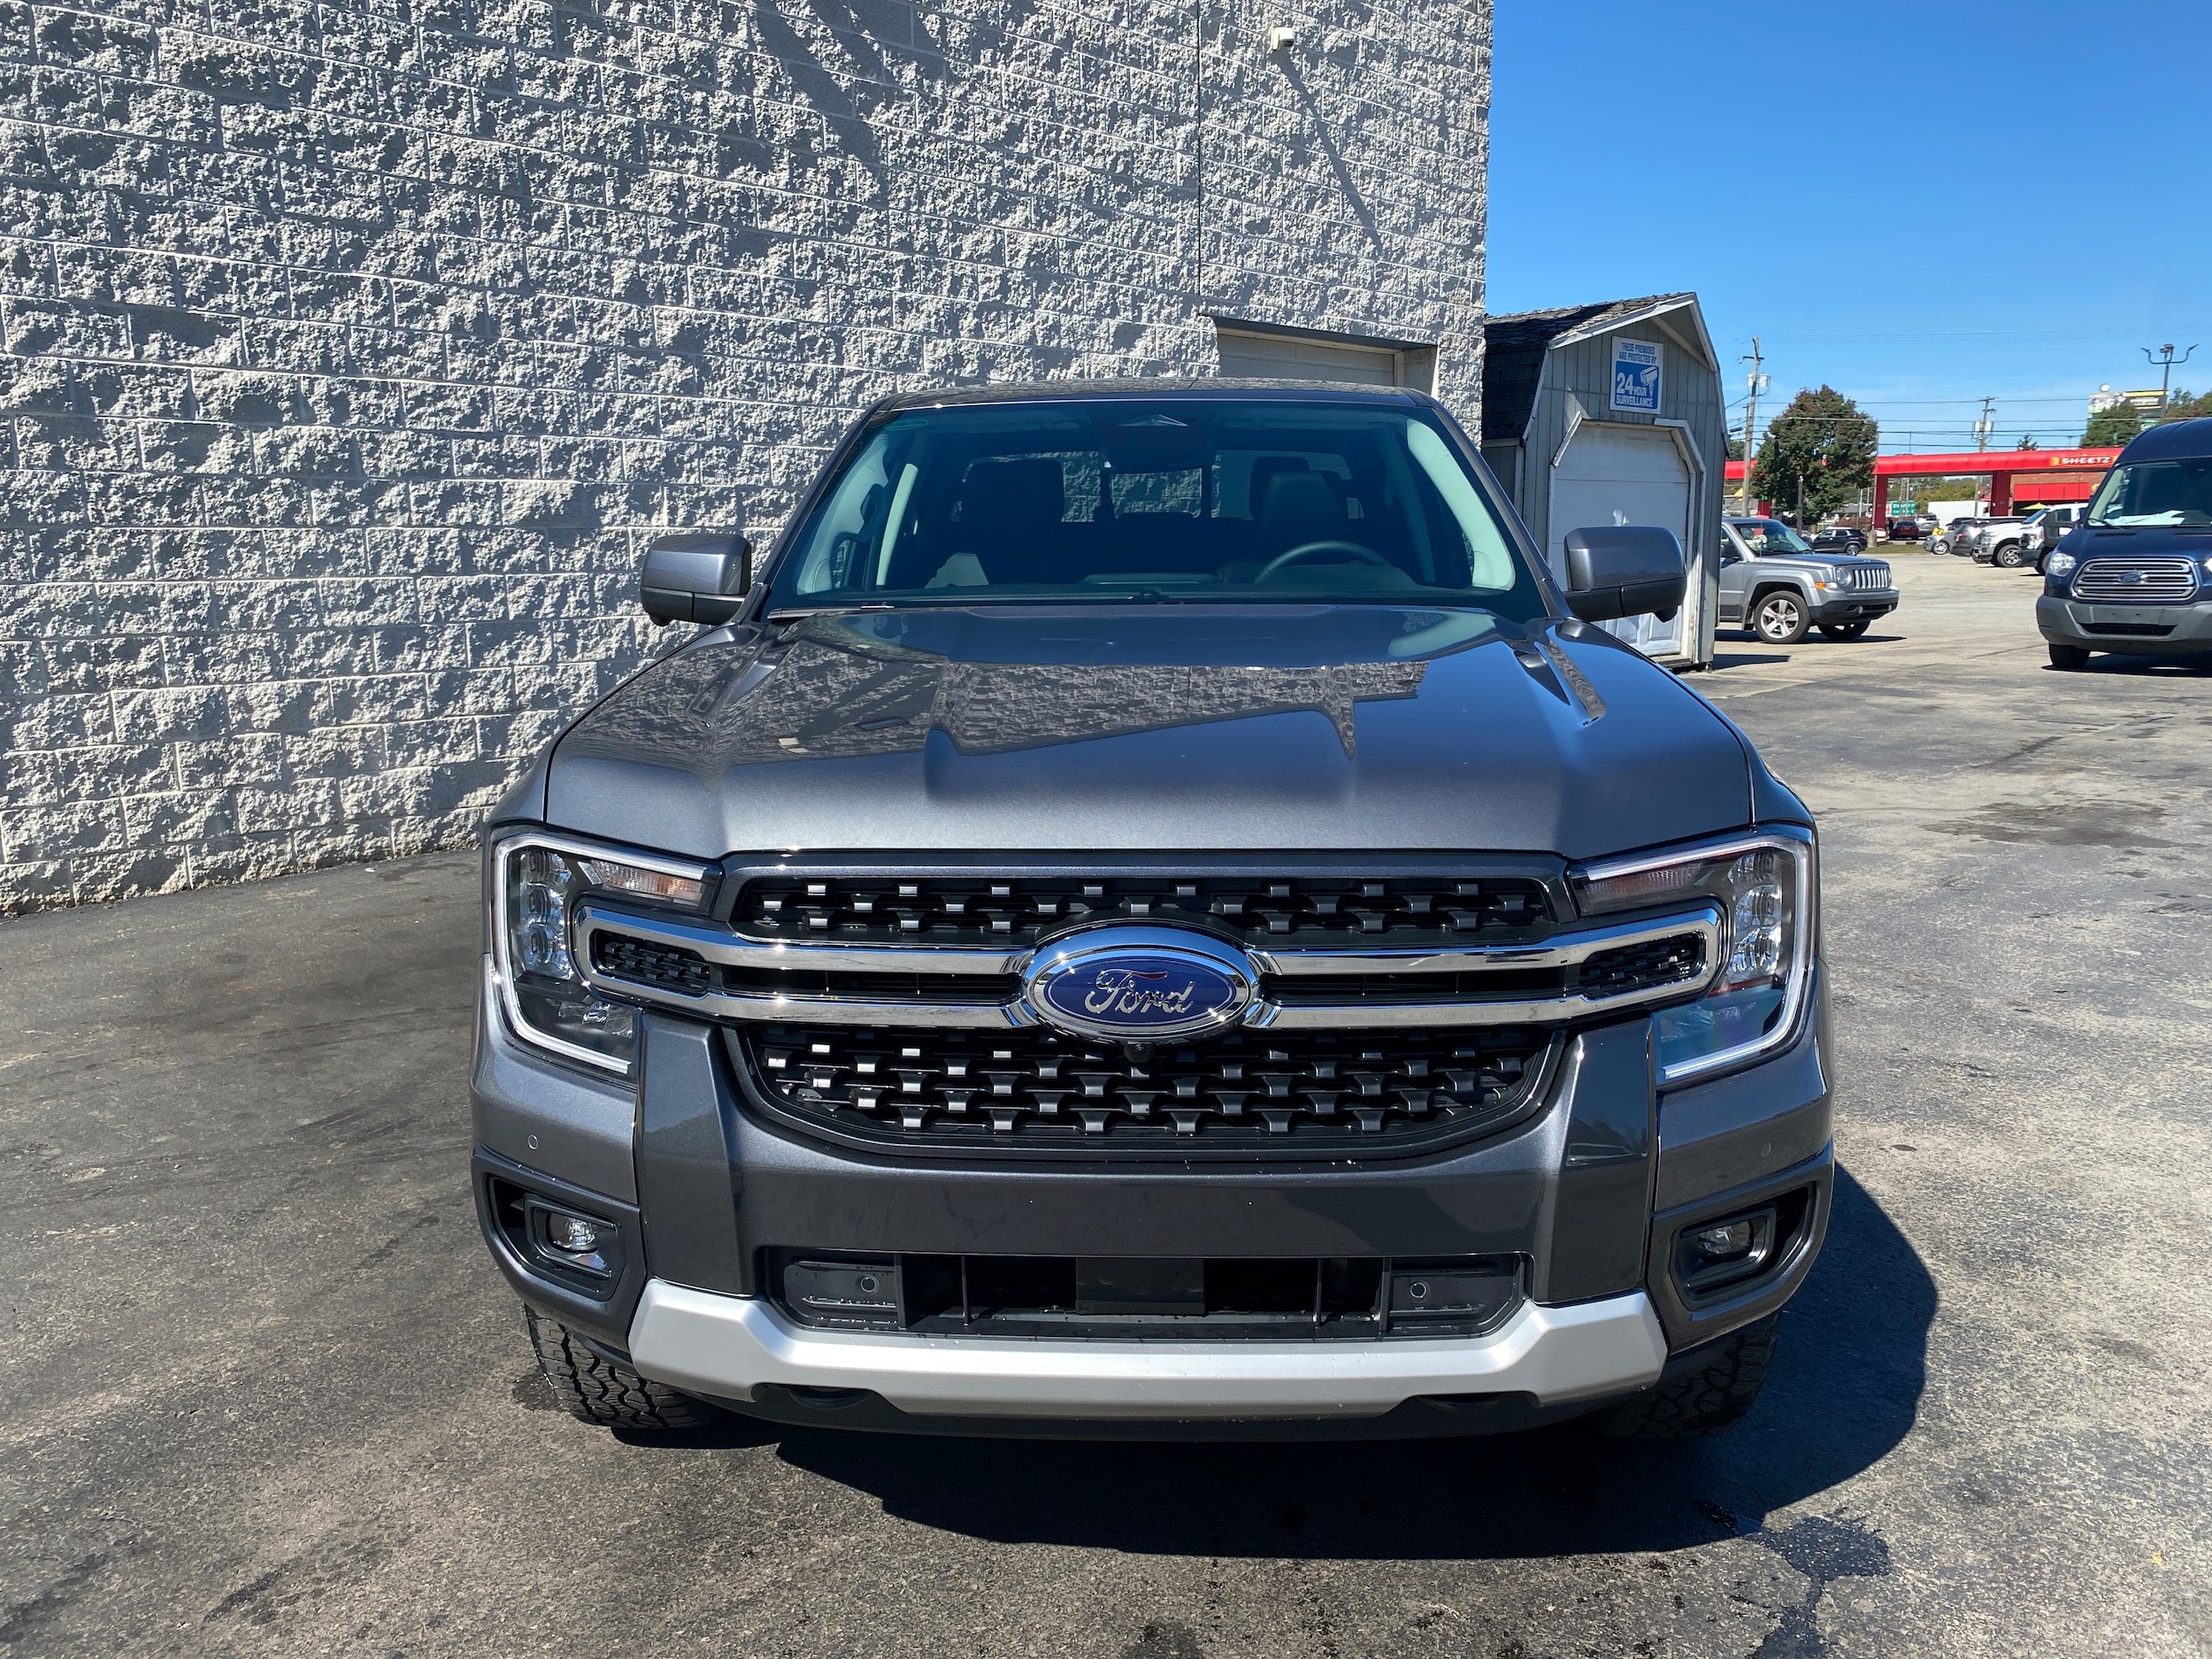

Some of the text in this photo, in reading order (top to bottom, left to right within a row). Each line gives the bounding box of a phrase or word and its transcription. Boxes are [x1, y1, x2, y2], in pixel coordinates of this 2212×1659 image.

[1621, 342, 1655, 354] THESE PREMISES
[1619, 350, 1628, 360] ARE
[1628, 352, 1651, 364] PROTECTED
[1617, 373, 1647, 396] 24 HOUR
[1616, 396, 1654, 407] SURVEILLANCE
[1084, 968, 1196, 1013] Ford
